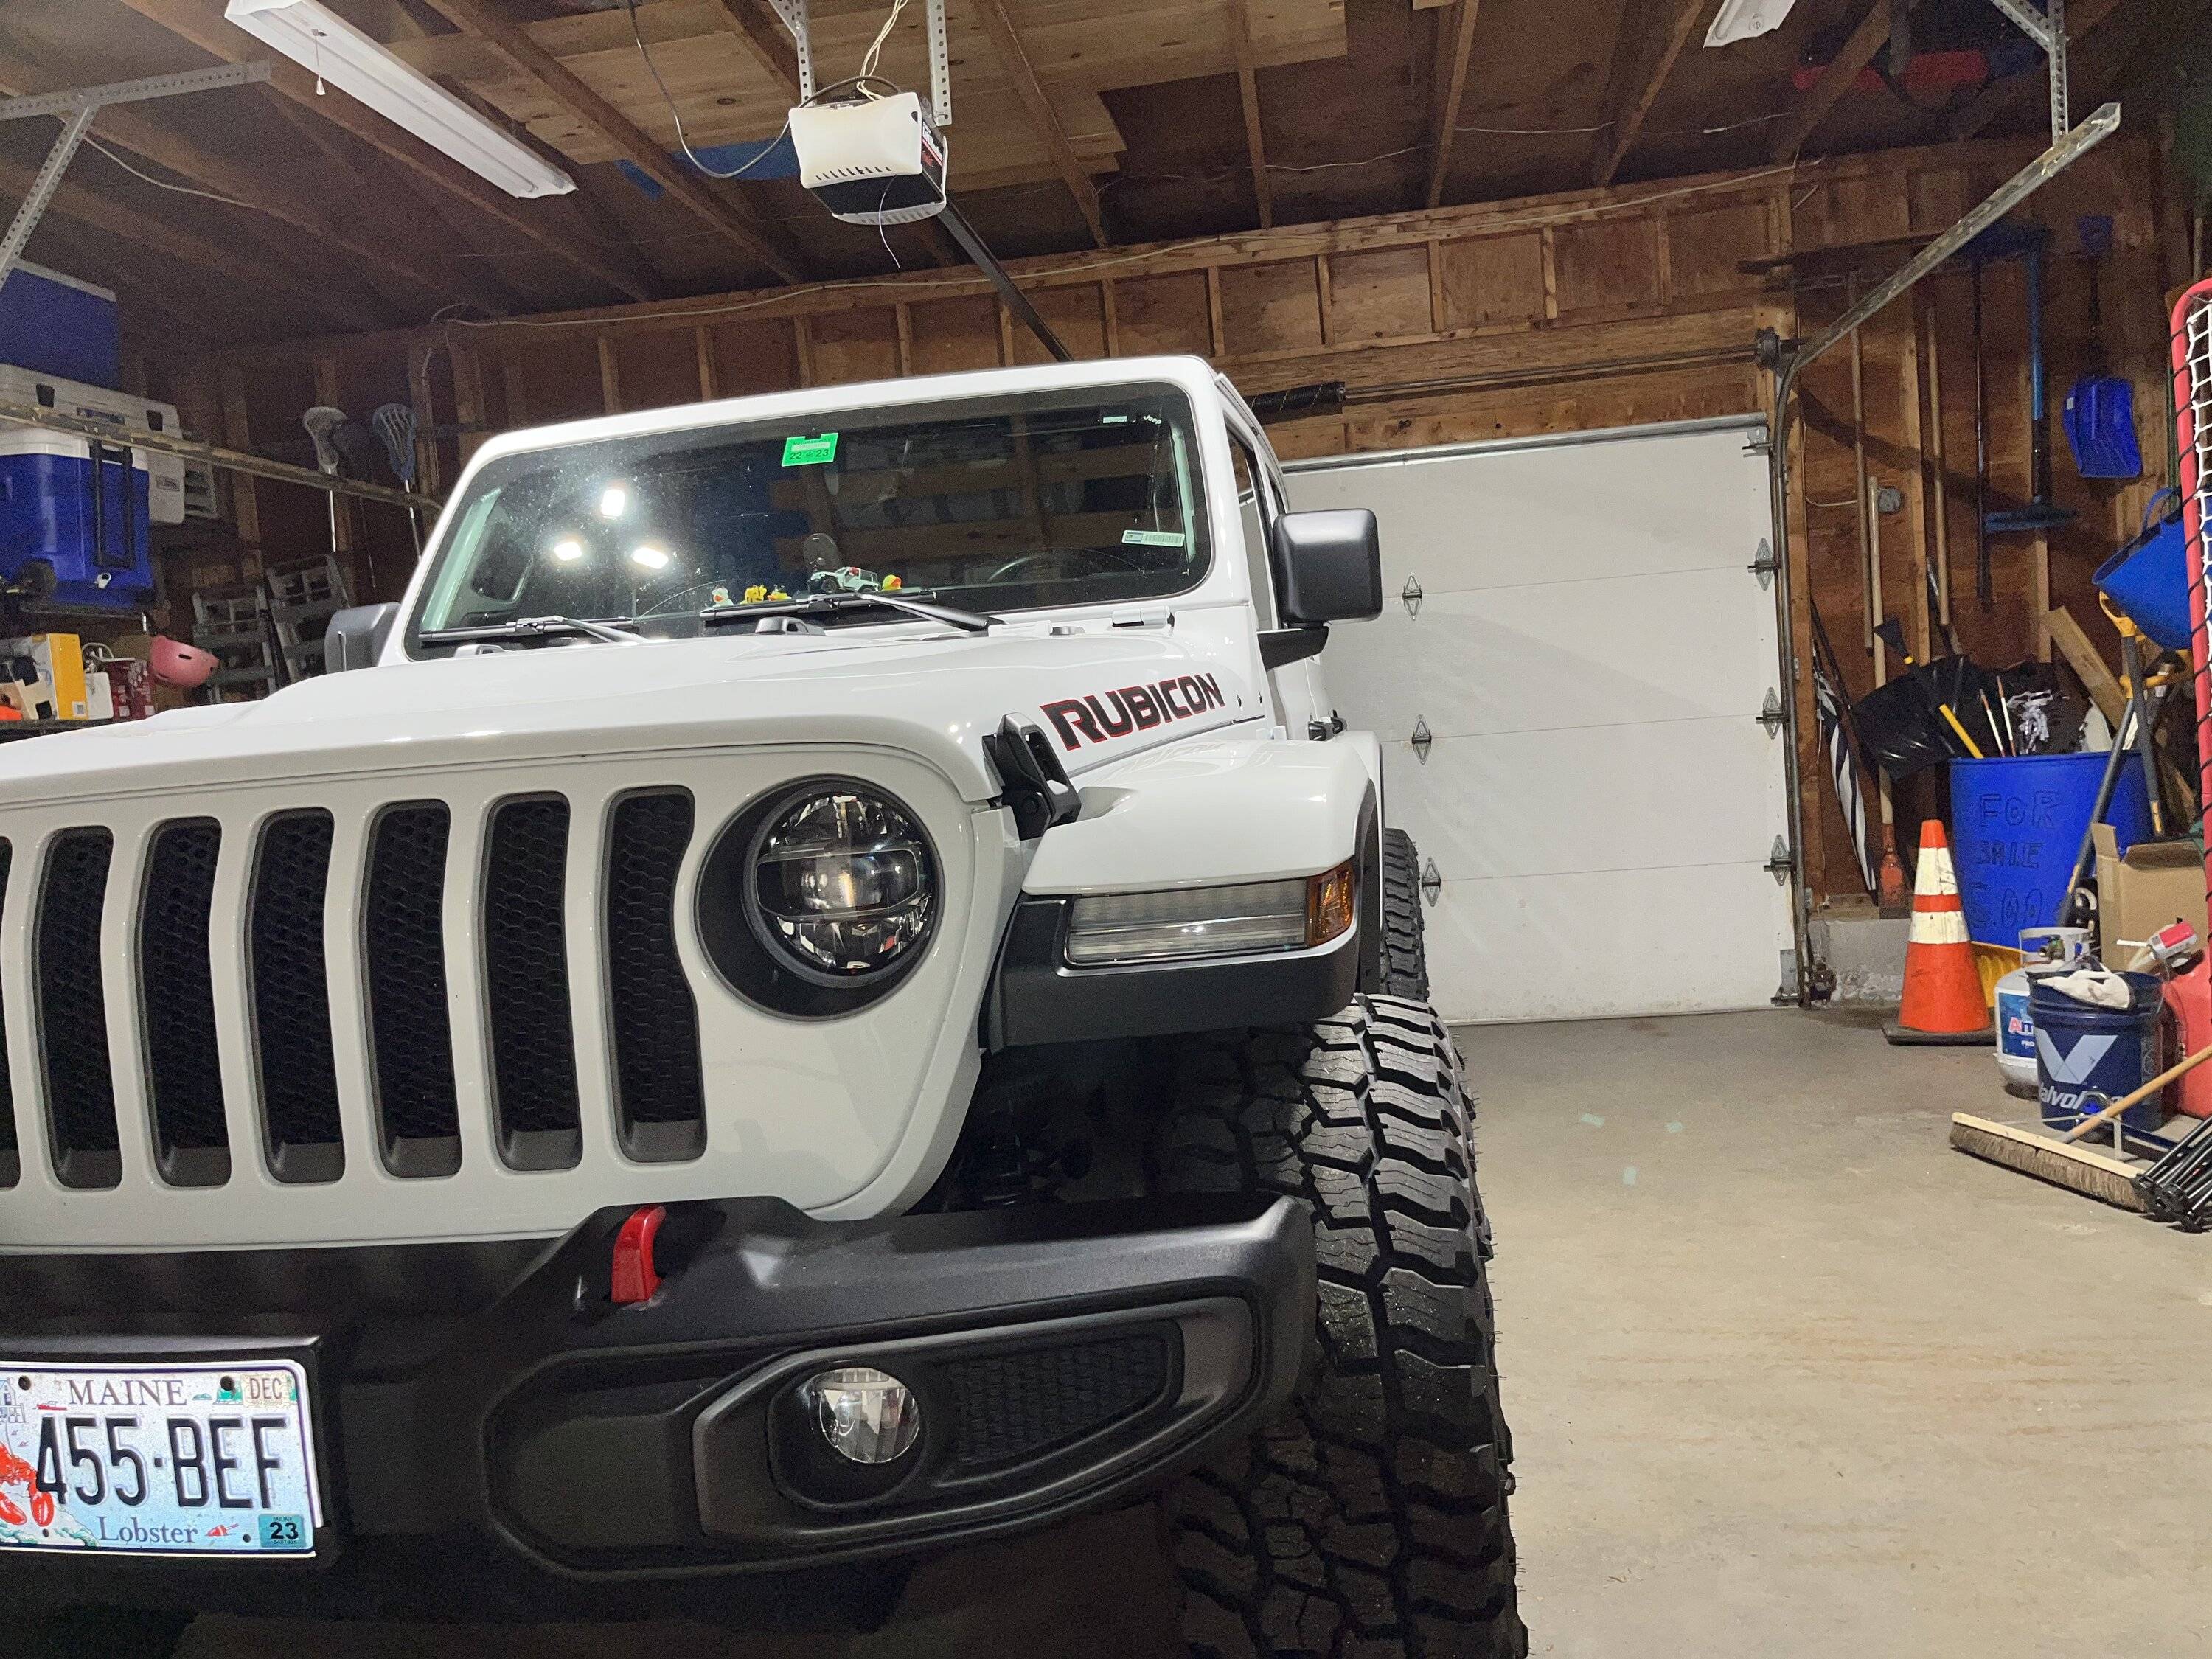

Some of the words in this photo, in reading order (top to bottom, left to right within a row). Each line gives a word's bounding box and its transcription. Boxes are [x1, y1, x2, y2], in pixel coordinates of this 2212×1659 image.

[790, 452, 802, 460] 22
[815, 449, 829, 457] 23
[1039, 672, 1225, 751] RUBICON
[1979, 790, 2063, 830] FOR
[1978, 839, 2044, 868] SALE
[67, 1380, 187, 1405] MAINE
[249, 1377, 282, 1399] DEC
[98, 1516, 198, 1543] Lobster
[270, 1522, 299, 1539] 23
